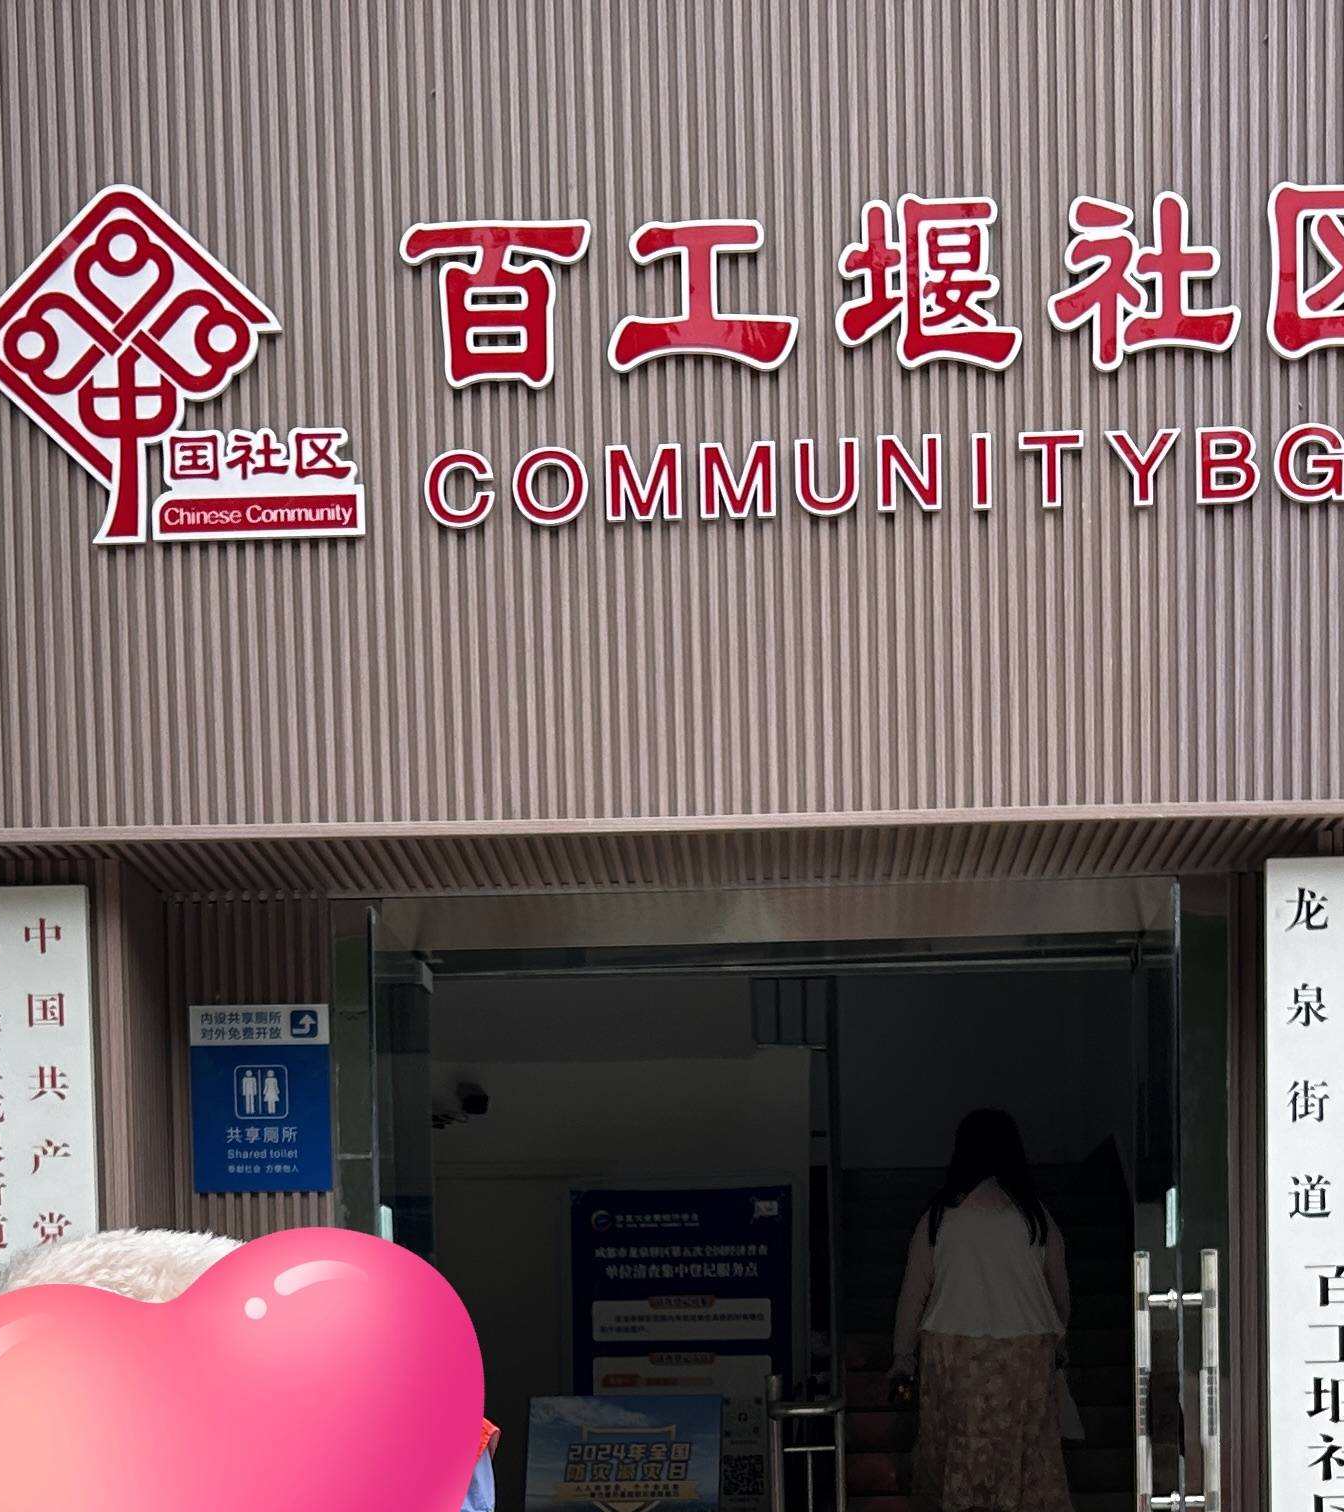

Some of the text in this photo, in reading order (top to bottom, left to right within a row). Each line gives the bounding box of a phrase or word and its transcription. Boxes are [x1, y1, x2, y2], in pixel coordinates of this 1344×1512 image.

[164, 501, 353, 525] Chinese Community
[200, 1011, 281, 1025] 内设共享厕所
[200, 1026, 283, 1040] 对外免费开放
[1284, 887, 1332, 1219] 龙泉街道
[24, 917, 72, 1246] 中国共产党
[226, 1126, 298, 1144] 共享厕所
[227, 1148, 298, 1160] Shared toilet
[568, 1442, 691, 1462] 2024年全国
